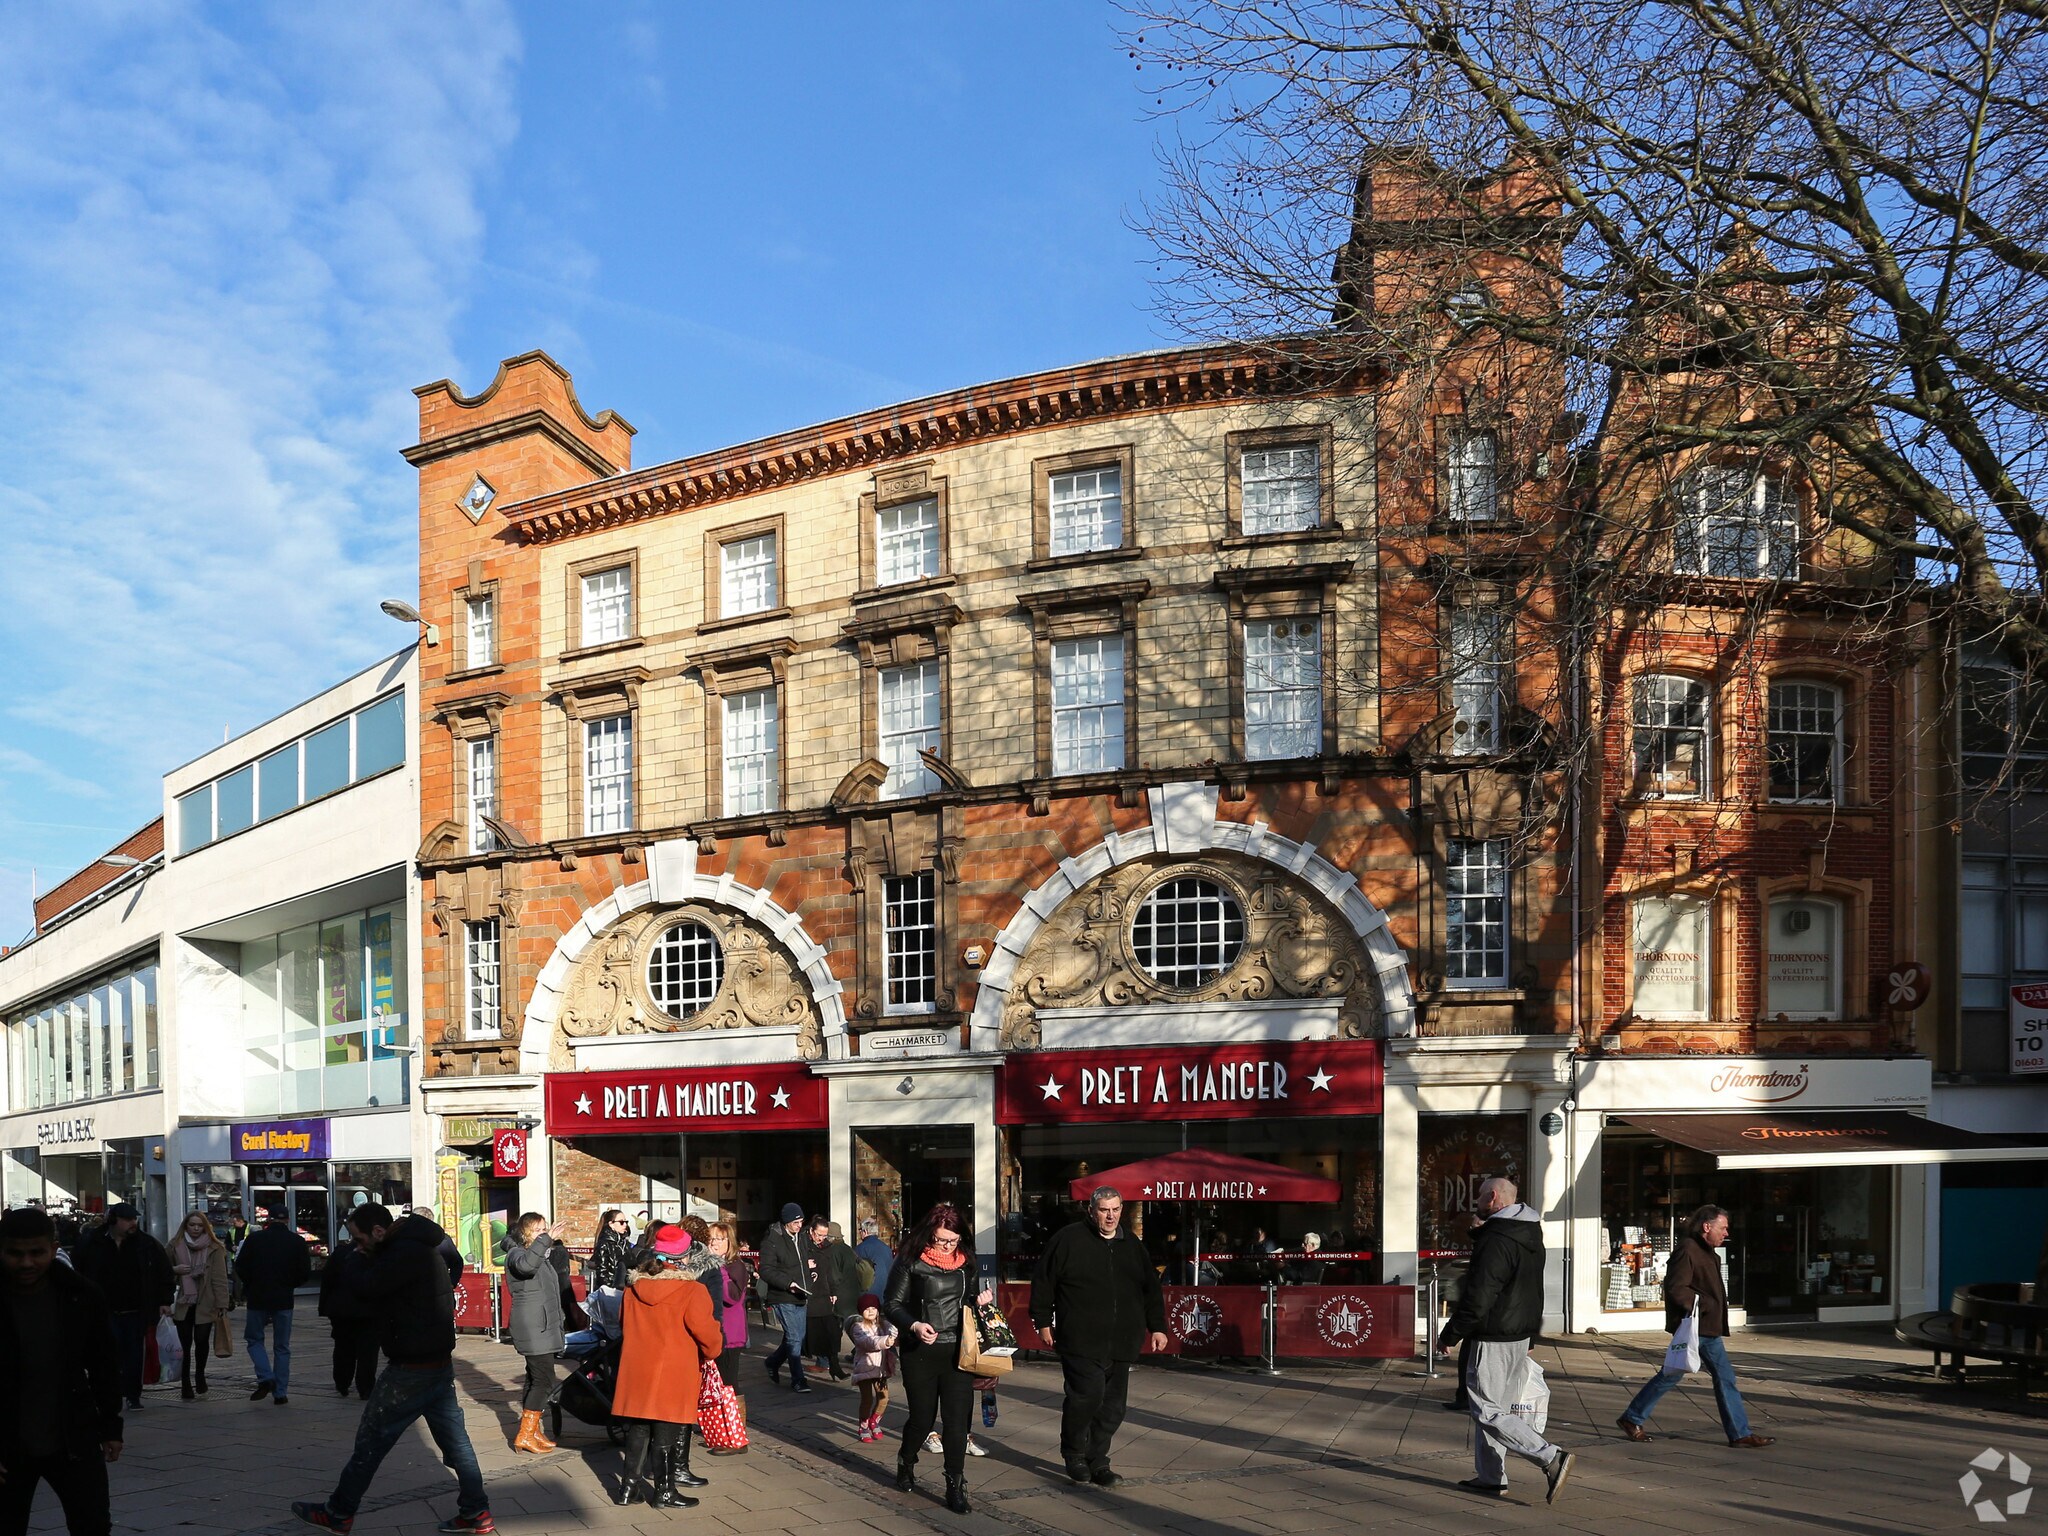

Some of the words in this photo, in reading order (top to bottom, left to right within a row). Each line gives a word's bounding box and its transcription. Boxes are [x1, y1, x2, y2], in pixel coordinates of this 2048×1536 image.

[1635, 952, 1699, 962] THORNTONS
[1768, 953, 1829, 962] THORNTONS
[889, 1035, 942, 1046] HAYMARKET
[2015, 1036, 2043, 1052] TO
[2015, 1058, 2044, 1067] 01603
[1082, 1065, 1142, 1104] PRET
[1153, 1065, 1169, 1103] A
[1181, 1061, 1288, 1102] MANGER
[1711, 1065, 1803, 1092] Thorntons
[604, 1085, 649, 1119] PRET
[656, 1084, 671, 1117] A
[676, 1081, 758, 1117] MANGER
[38, 1118, 95, 1145] PRIMARK
[241, 1131, 267, 1150] Card
[268, 1130, 311, 1153] Factory
[1156, 1181, 1184, 1199] PRET
[1189, 1181, 1197, 1198] A
[1202, 1181, 1254, 1199] MANGER
[1171, 1294, 1198, 1318] ORGANIC
[1200, 1295, 1223, 1318] COFFEE
[1317, 1294, 1347, 1319] ORGANIC
[1350, 1295, 1374, 1319] COFFEE
[1182, 1311, 1210, 1331] PRET
[1331, 1312, 1361, 1332] PRET
[1172, 1327, 1203, 1346] NATURAL
[1205, 1327, 1221, 1344] FOOD
[1319, 1328, 1353, 1349] NATURAL
[1354, 1328, 1372, 1346] FOOD
